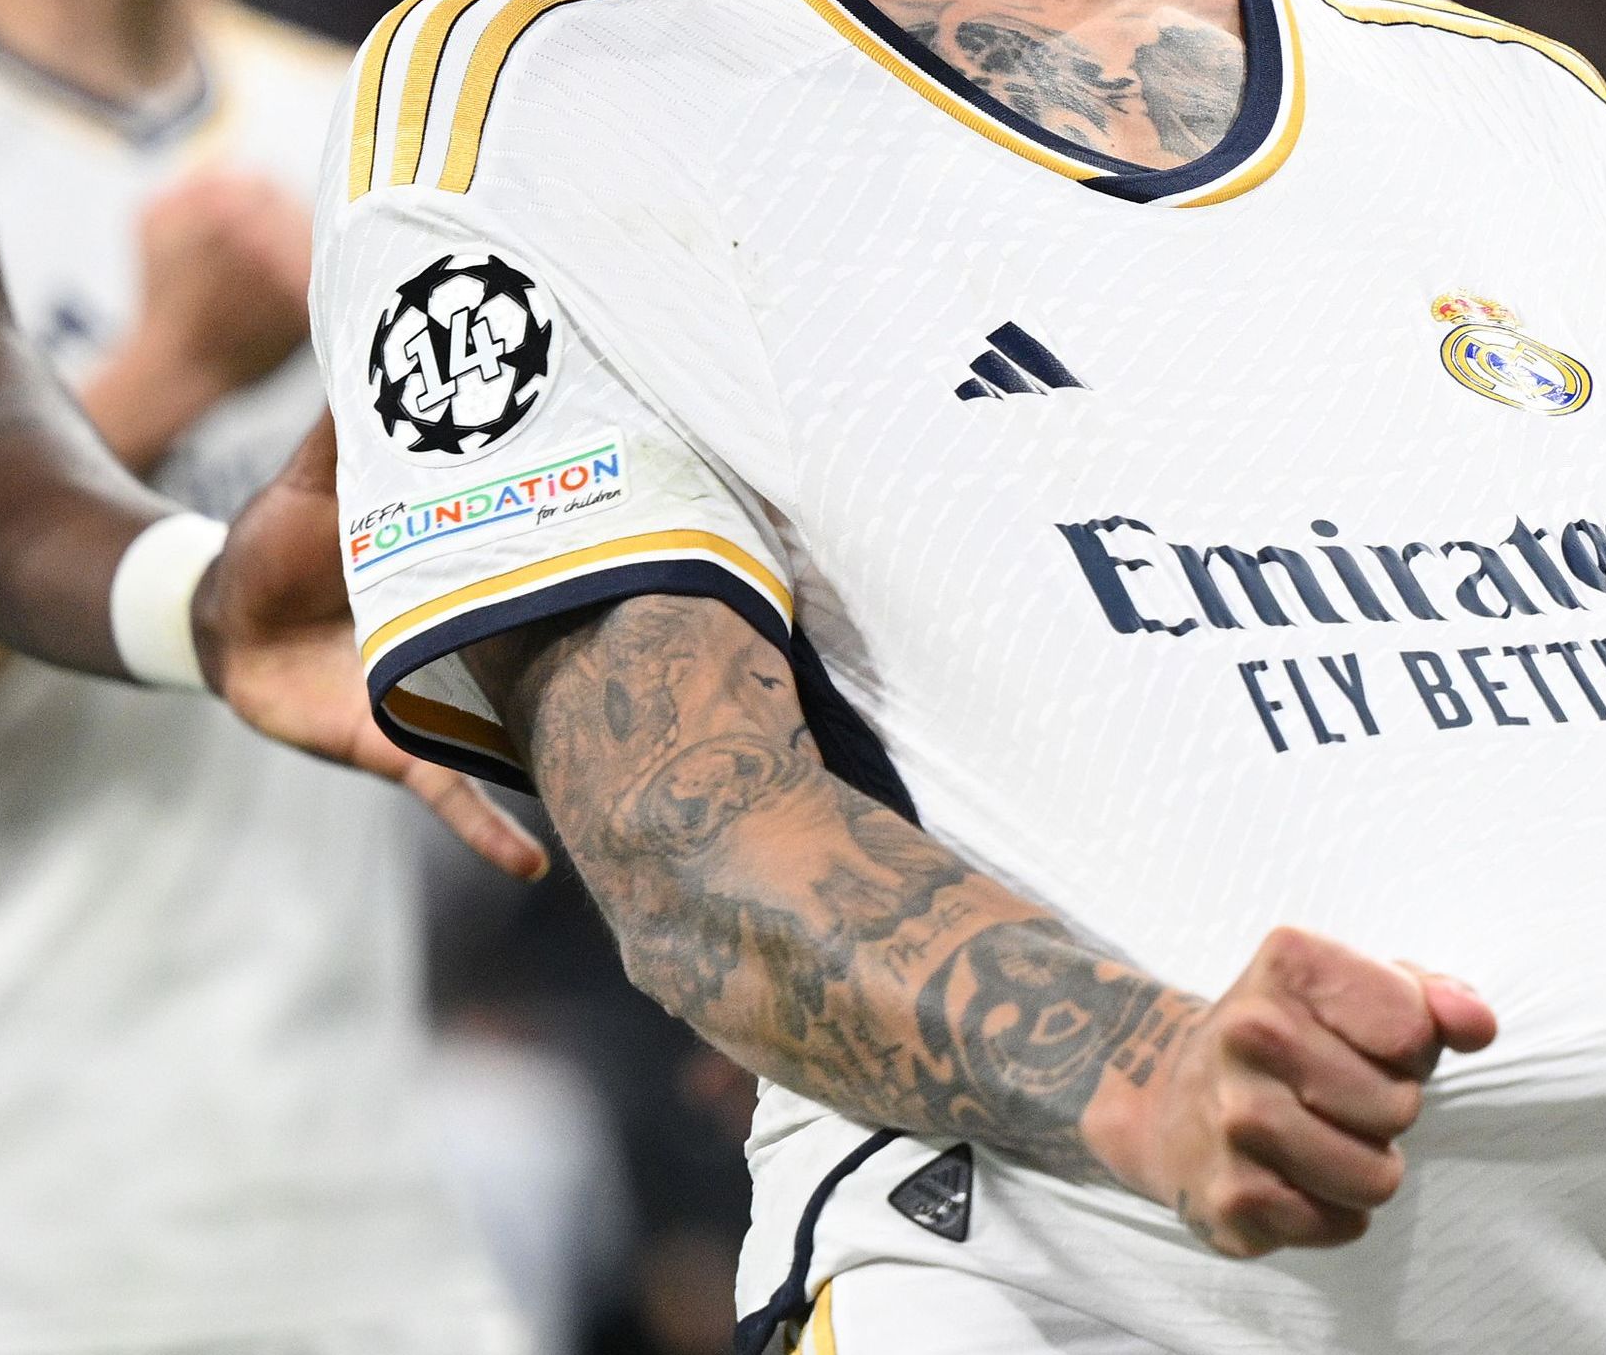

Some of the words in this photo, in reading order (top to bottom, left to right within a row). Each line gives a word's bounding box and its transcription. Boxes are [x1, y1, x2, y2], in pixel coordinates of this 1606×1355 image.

[405, 307, 505, 413] 14
[350, 502, 407, 535] UEFA
[536, 505, 556, 525] for
[563, 489, 621, 514] children
[1237, 652, 1380, 753] FLY
